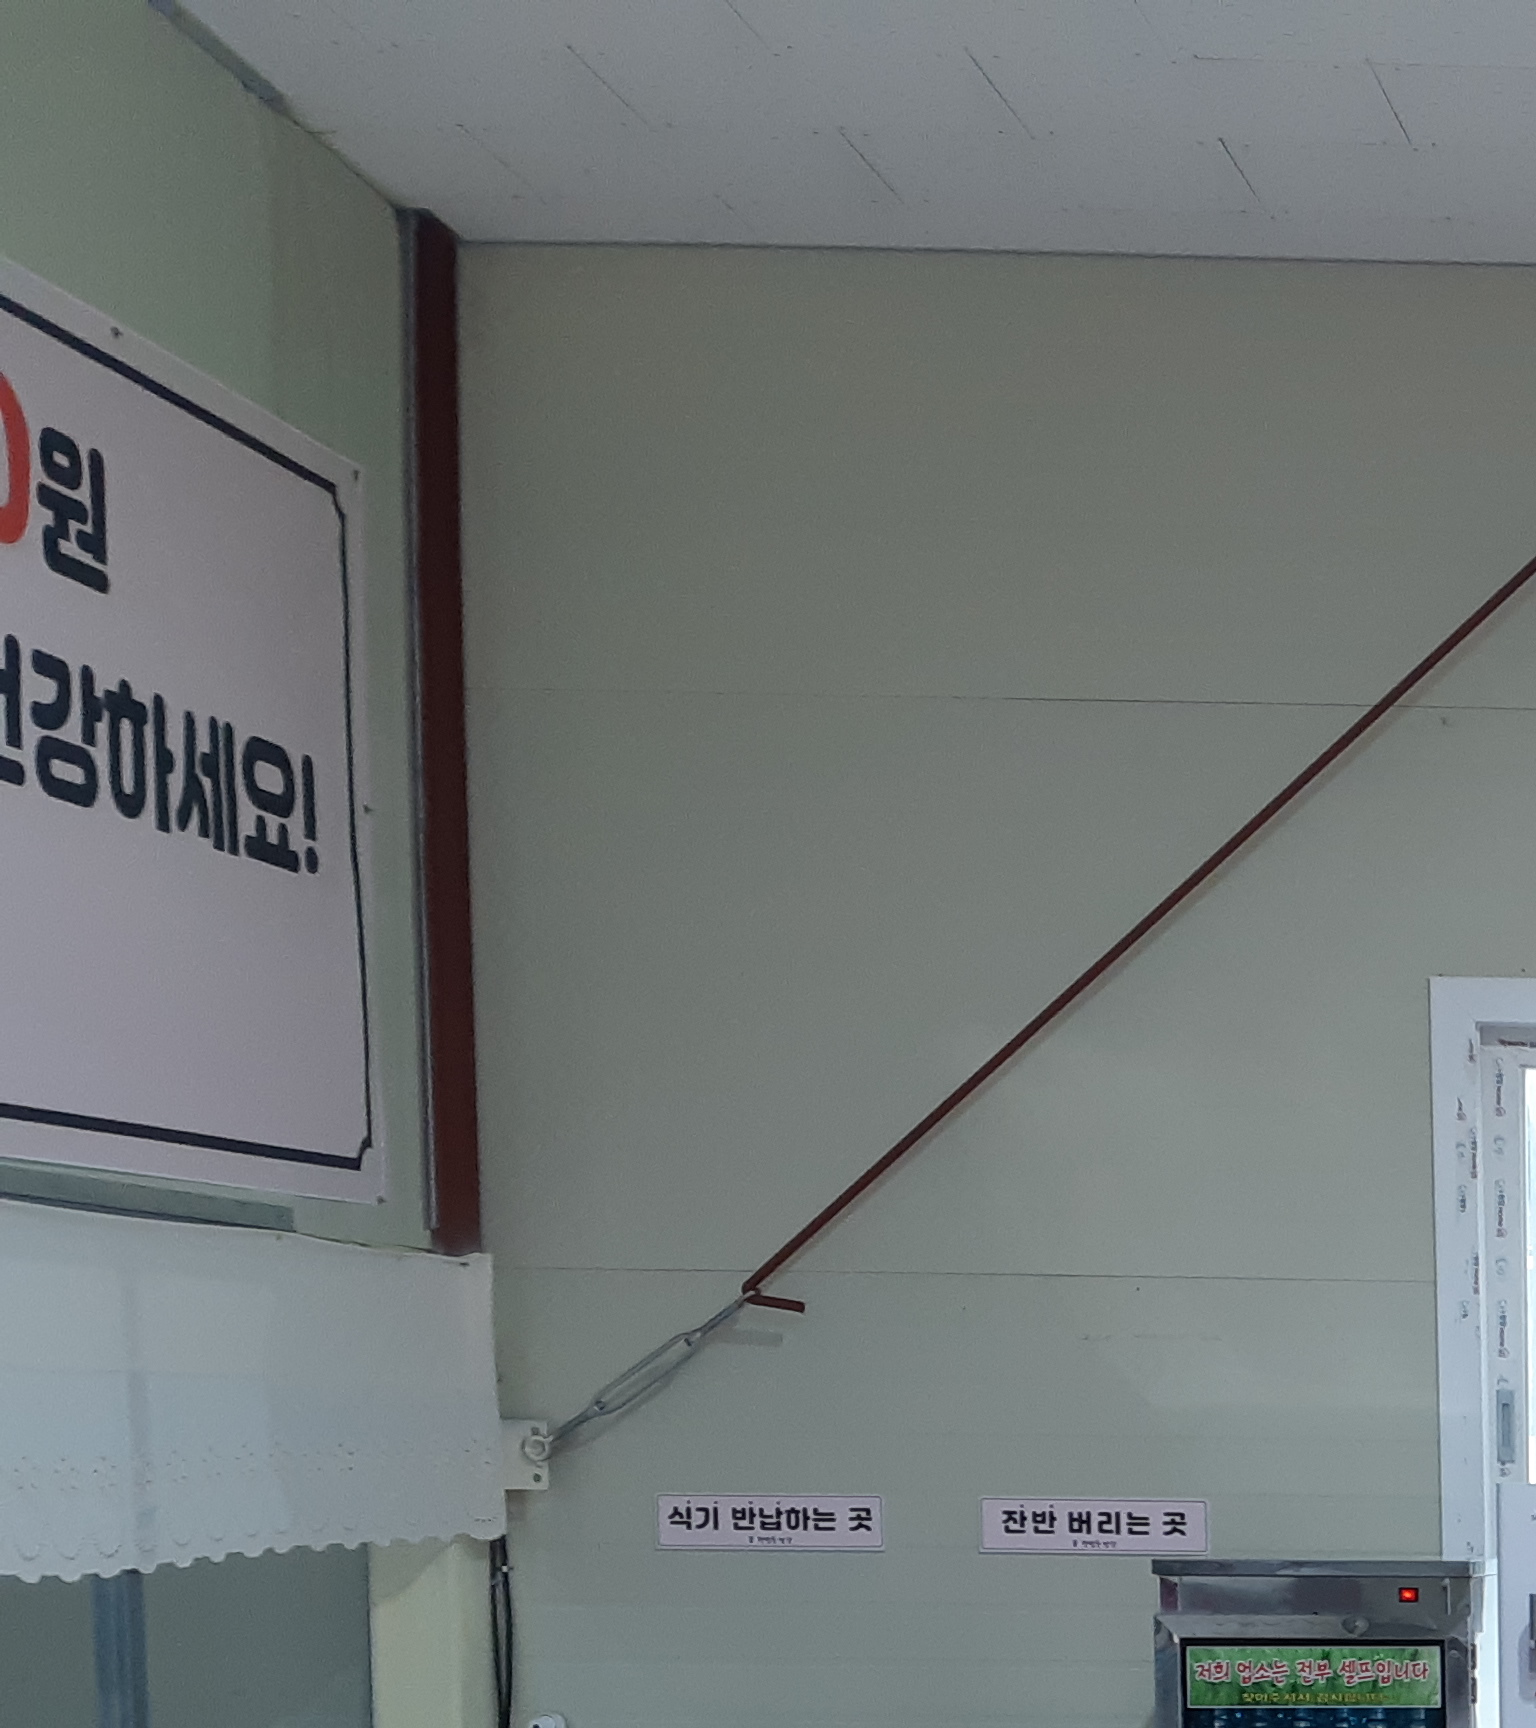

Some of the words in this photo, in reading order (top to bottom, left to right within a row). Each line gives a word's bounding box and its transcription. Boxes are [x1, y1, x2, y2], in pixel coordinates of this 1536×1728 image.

[668, 1504, 720, 1531] 식기
[731, 1504, 837, 1532] 반납하는
[848, 1507, 873, 1532] 곳
[1001, 1508, 1057, 1534] 잔반
[1067, 1510, 1151, 1536] 버리는
[1161, 1511, 1187, 1537] 곳
[1195, 1661, 1231, 1682] 저희
[1236, 1659, 1290, 1685] 업소는
[1296, 1660, 1332, 1684] 전부
[1338, 1659, 1429, 1686] 셀프입니다
